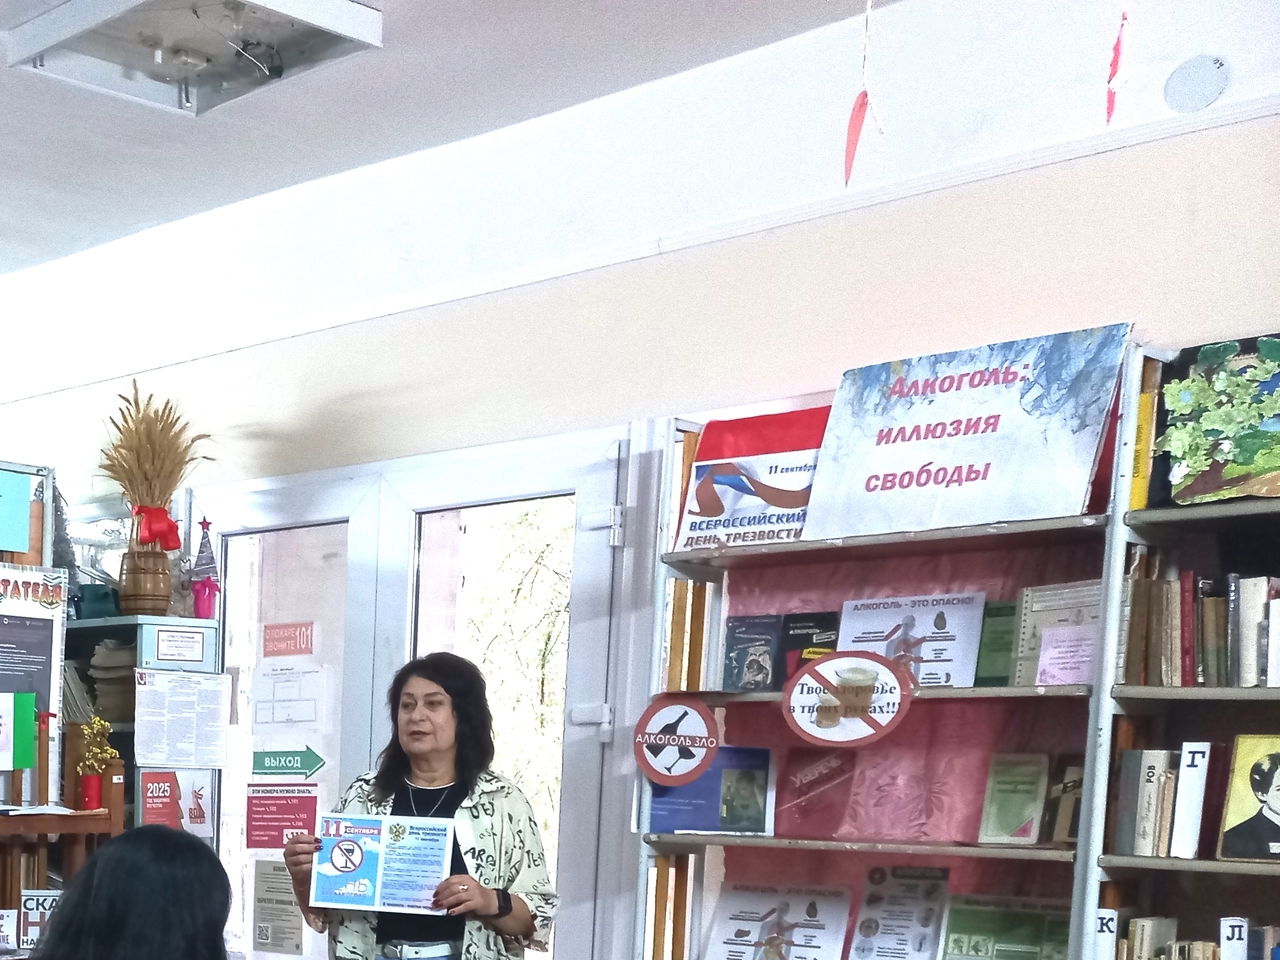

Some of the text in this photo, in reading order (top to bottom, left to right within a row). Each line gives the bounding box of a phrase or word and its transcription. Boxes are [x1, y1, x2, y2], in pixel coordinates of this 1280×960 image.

[888, 363, 1030, 399] Алкоголь:
[875, 414, 1001, 446] иллюзия
[768, 465, 778, 474] 11
[865, 461, 991, 492] свободы
[689, 509, 808, 532] ВСЕРОССИЙСКИЙ
[683, 528, 803, 548] ДЕНЬ ТРЕЗВОСТИ
[853, 601, 902, 611] АЛКОГОЛЬ
[910, 600, 929, 608] ЭТО
[296, 626, 312, 649] 101
[635, 733, 717, 748] АЛКОГОЛЬ ЗЛО
[264, 756, 301, 768] ВЫХОД
[1186, 751, 1206, 768] Г
[147, 782, 170, 797] 2025
[322, 819, 379, 838] 11 СЕНТЯБРЯ
[1097, 917, 1115, 933] К
[1226, 925, 1244, 941] Л
